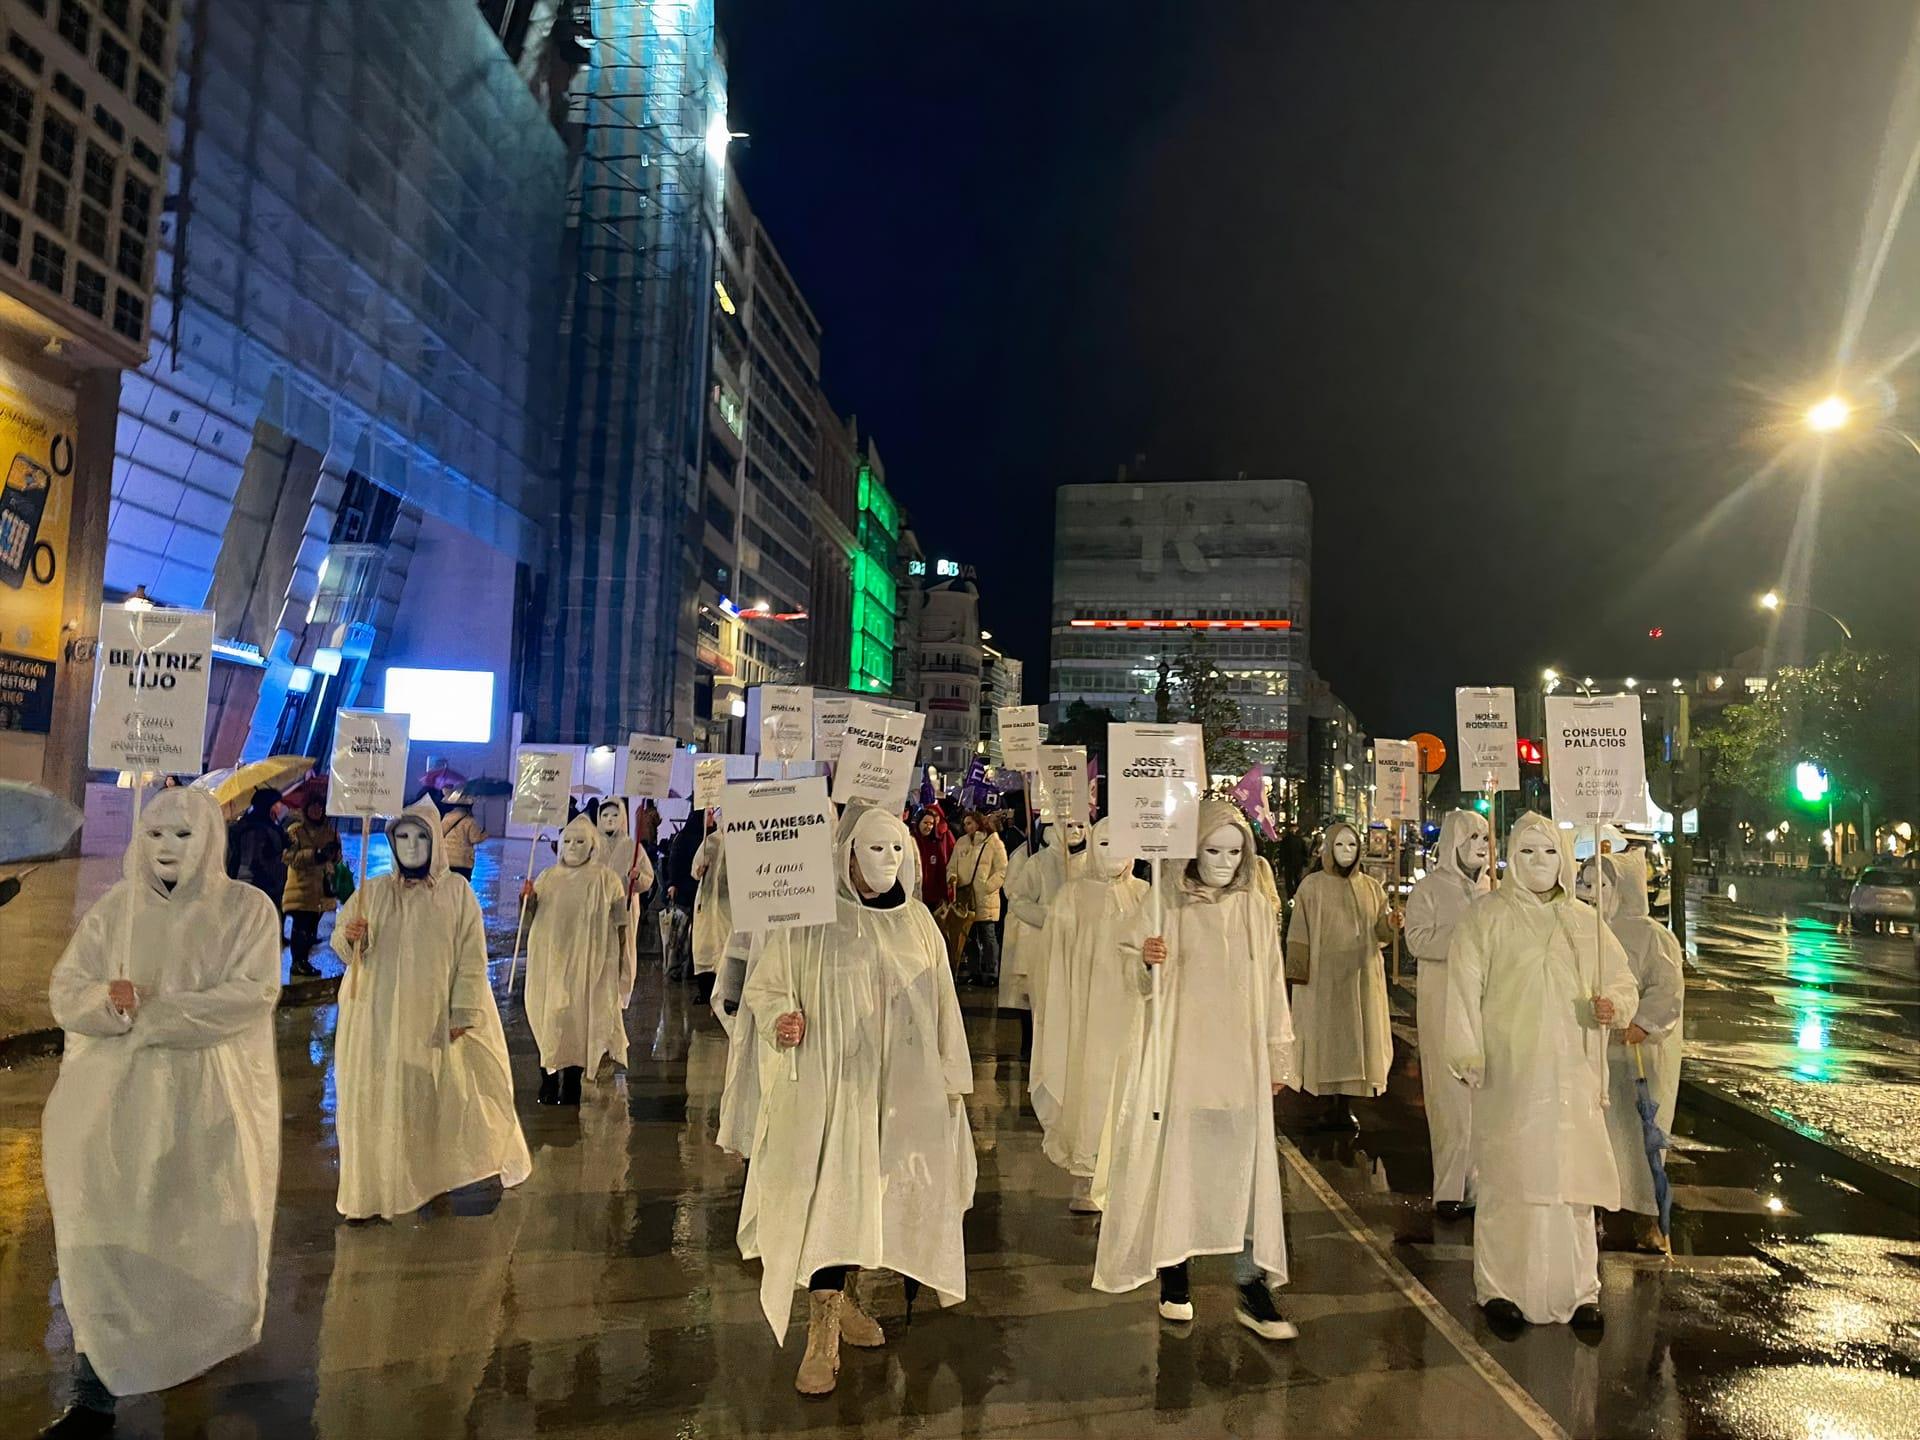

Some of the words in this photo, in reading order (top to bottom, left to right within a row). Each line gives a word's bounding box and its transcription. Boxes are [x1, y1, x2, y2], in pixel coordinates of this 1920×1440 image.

[937, 559, 977, 578] BBVA
[109, 649, 202, 672] BEATRIZ
[1562, 727, 1627, 738] CONSUELO
[1564, 738, 1626, 748] PALACIOS
[1131, 757, 1176, 767] JOSEFA
[1576, 764, 1591, 777] 87
[727, 819, 756, 833] ANA
[759, 813, 826, 831] VANESSA
[755, 862, 771, 876] 44
